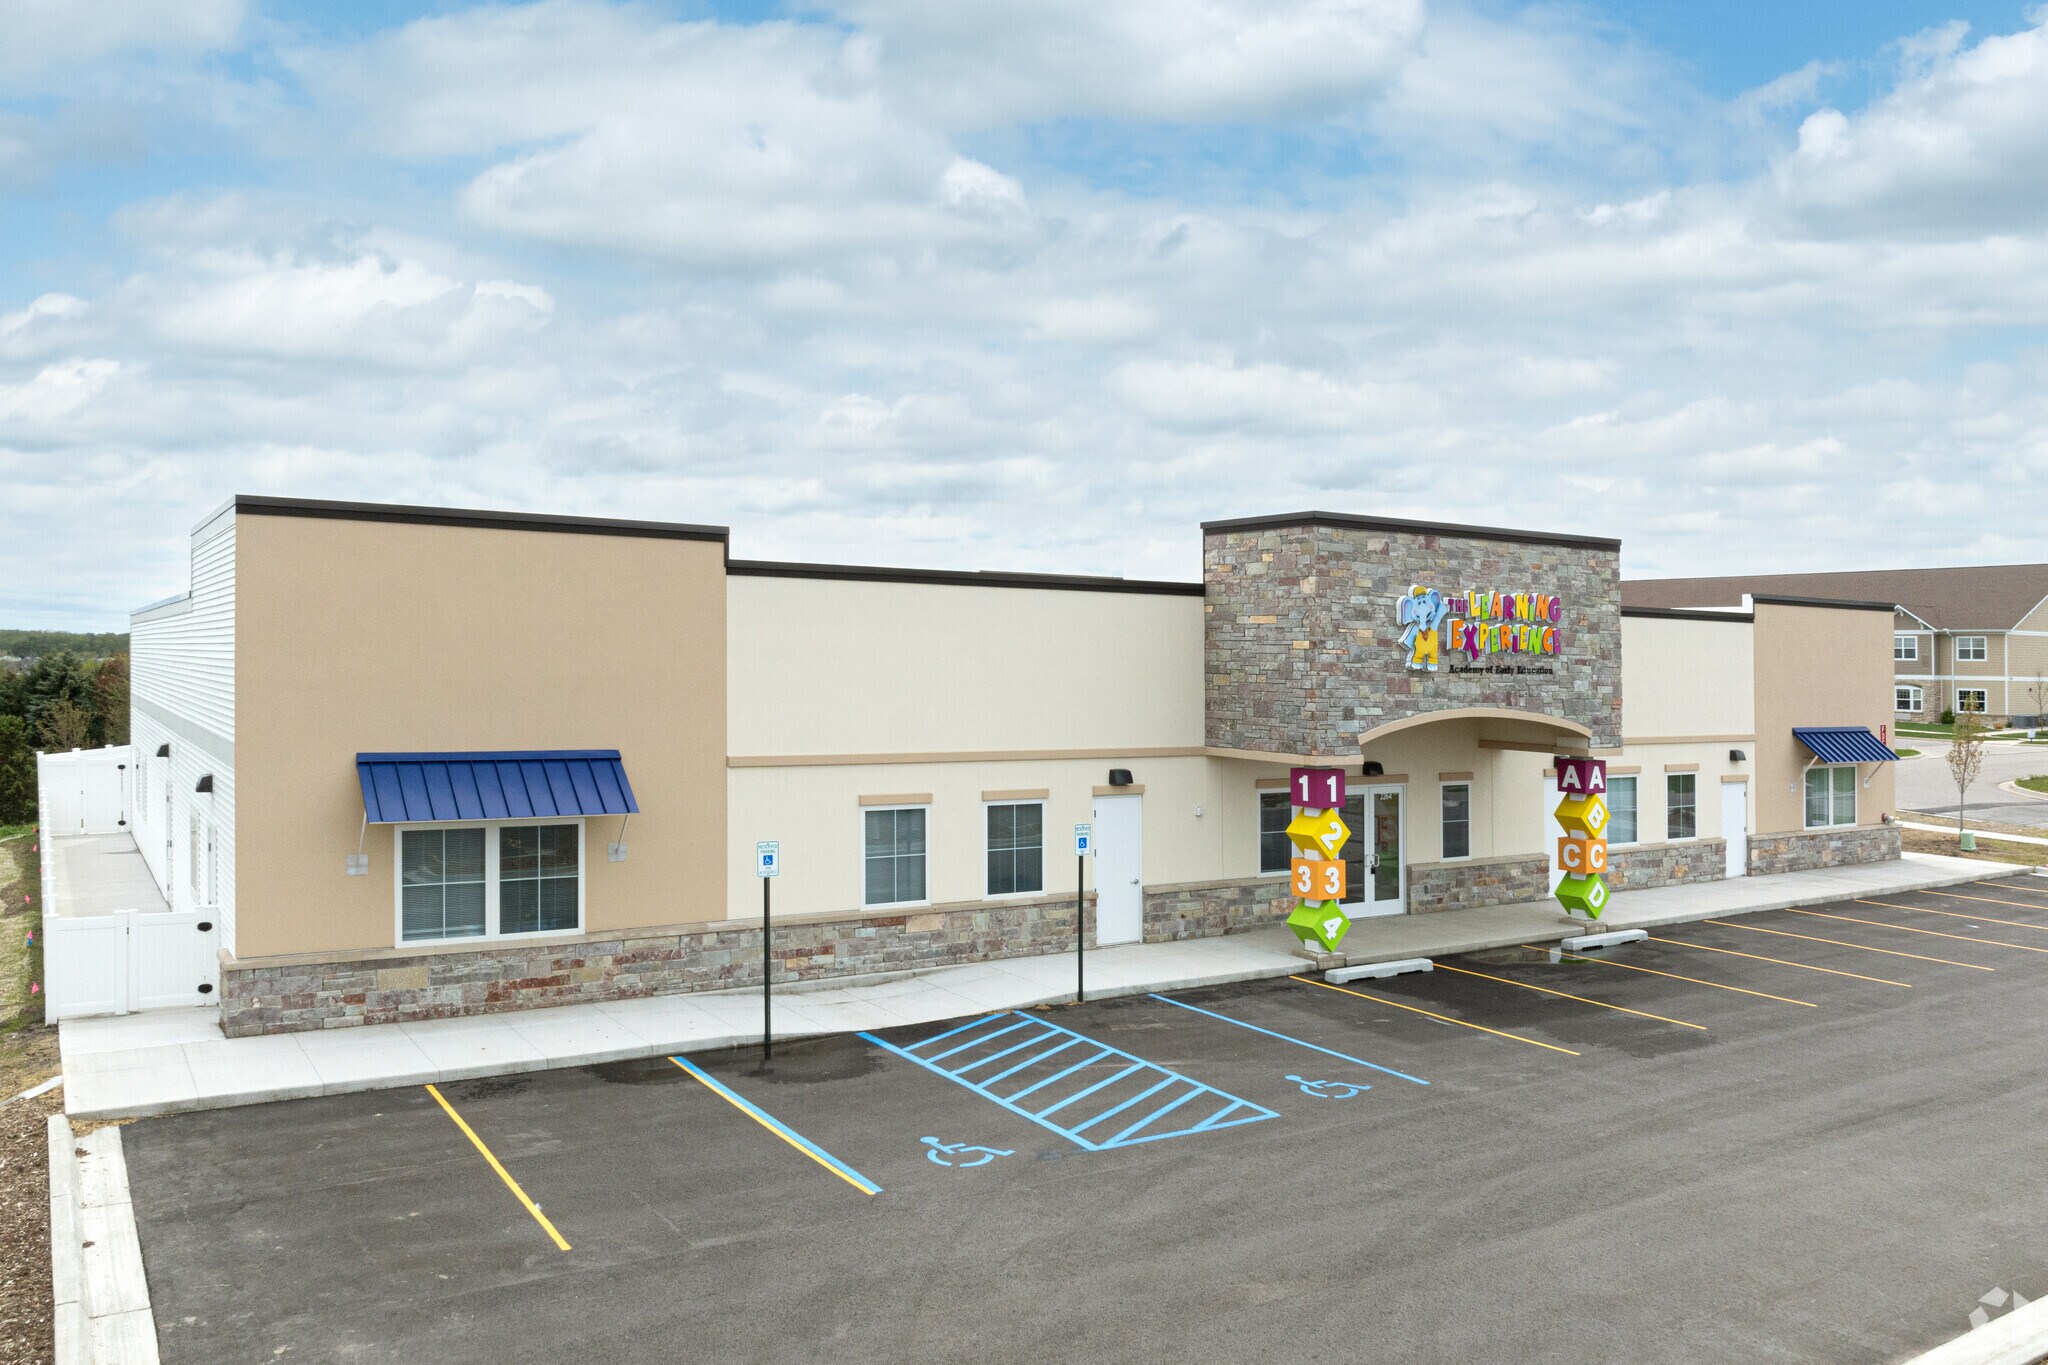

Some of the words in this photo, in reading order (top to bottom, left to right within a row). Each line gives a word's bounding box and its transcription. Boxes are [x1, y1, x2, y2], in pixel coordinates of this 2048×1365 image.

[1447, 598, 1469, 613] THE
[1449, 665, 1484, 675] Academy
[1486, 665, 1493, 674] of
[1496, 666, 1515, 676] Early
[1517, 666, 1553, 675] Education
[1299, 775, 1309, 801] 1
[1326, 775, 1337, 802] 1
[1561, 765, 1582, 789] A
[1589, 766, 1604, 789] A
[1587, 802, 1605, 829] B
[1320, 821, 1343, 851] 2
[1563, 844, 1581, 868] C
[1590, 844, 1604, 868] C
[1297, 865, 1311, 893] 3
[1325, 866, 1340, 894] 3
[1588, 881, 1605, 908] D
[1323, 916, 1343, 941] 4
